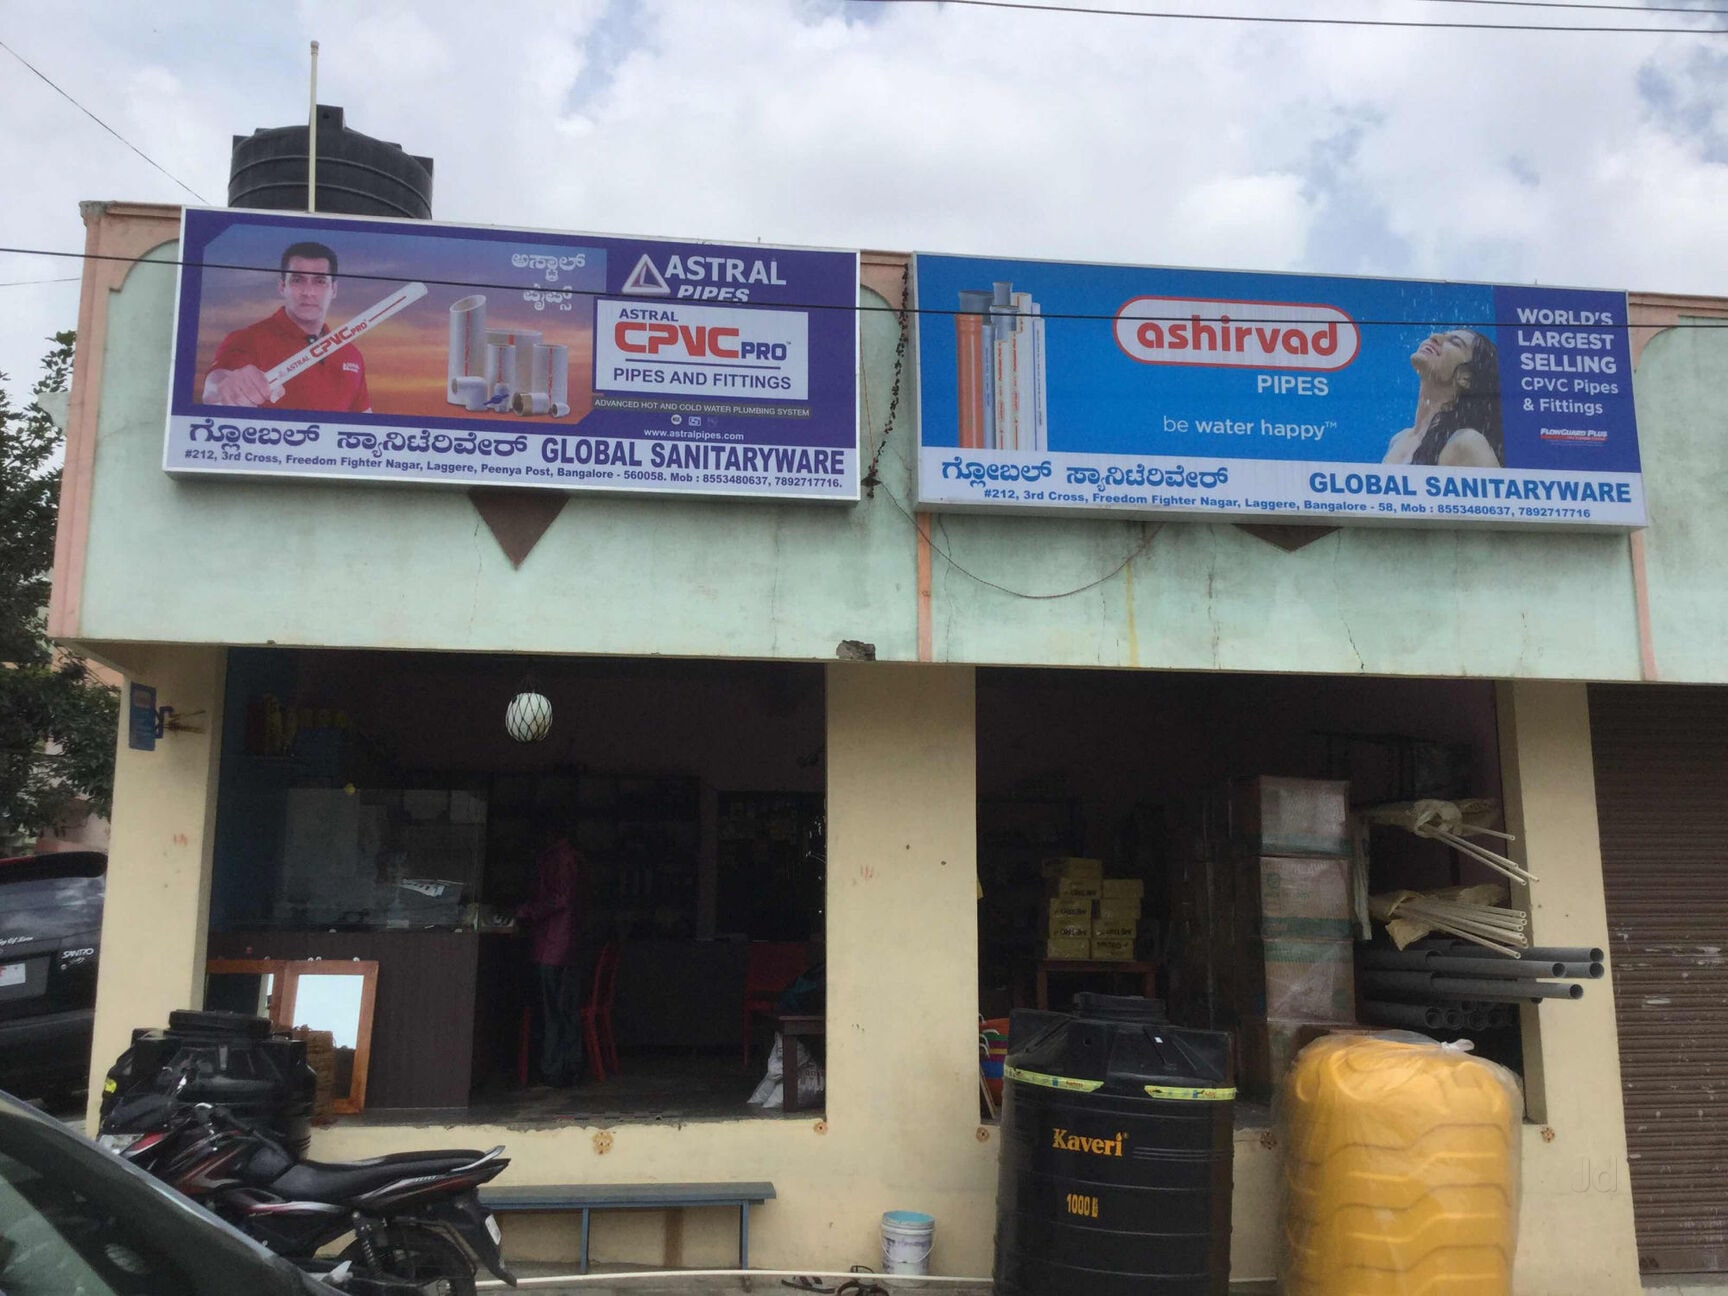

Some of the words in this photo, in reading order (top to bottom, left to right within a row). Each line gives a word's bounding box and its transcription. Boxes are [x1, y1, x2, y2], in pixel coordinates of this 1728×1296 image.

[664, 254, 787, 286] ASTRAL
[676, 285, 750, 302] PIPES
[618, 308, 679, 322] ASTRAL
[1516, 308, 1614, 325] WORLD'S
[309, 326, 353, 358] CPVC
[614, 321, 740, 359] CPVC
[1136, 314, 1338, 356] ashirvad
[1517, 330, 1615, 350] LARGEST
[1520, 352, 1617, 374] SELLING
[613, 367, 665, 384] PIPES
[670, 371, 707, 385] AND
[713, 373, 792, 389] FITTINGS
[1257, 374, 1329, 396] PIPES
[1521, 377, 1569, 392] CPVC
[1573, 379, 1619, 396] Pipes
[594, 399, 640, 408] ADVANCED
[640, 401, 658, 409] HOT
[660, 402, 678, 410] AND
[679, 403, 702, 411] COLD
[703, 404, 732, 413] WATER
[732, 406, 776, 415] PLUMBING
[777, 408, 810, 417] SYSTEM
[1522, 397, 1535, 411] &
[1539, 398, 1604, 417] Fittings
[189, 418, 320, 451] ಗ್ಲೋಬಲ್
[644, 428, 744, 441] www.astralpipes.com
[1163, 416, 1188, 432] be
[1195, 419, 1254, 435] water
[541, 437, 642, 467] GLOBAL
[650, 442, 845, 475] SANITARYWARE
[184, 449, 218, 461] #212,
[221, 451, 241, 461] 3rd
[245, 452, 282, 465] Cross,
[286, 454, 337, 466] Freedom
[341, 457, 382, 469] Fighter
[385, 459, 424, 472] Nagar,
[427, 461, 477, 474] Laggere,
[481, 463, 522, 476] Peenya
[525, 466, 554, 478] Post,
[557, 468, 614, 480] Bangalore
[670, 472, 693, 483] Mob
[702, 474, 772, 487] 8553480637,
[942, 456, 1052, 488] ಗ್ಲೋಬಲ್
[1309, 472, 1417, 496] GLOBAL
[1425, 476, 1632, 503] SANITARYWARE
[984, 489, 1019, 500] #212,
[1023, 490, 1044, 500] 3rd
[1048, 491, 1089, 503] Cross,
[1092, 492, 1147, 504] Freedom
[1151, 494, 1196, 506] Fighter
[1201, 497, 1241, 509] Nagar,
[1245, 498, 1300, 510] Laggere,
[1304, 499, 1367, 512] Bangalore
[1378, 502, 1397, 513] 58,
[1400, 503, 1426, 513] Mob
[1437, 504, 1515, 517] 8553480637,
[1518, 506, 1591, 518] 7892717716
[1052, 1128, 1123, 1157] Kaveri
[1066, 1193, 1090, 1216] 1000
